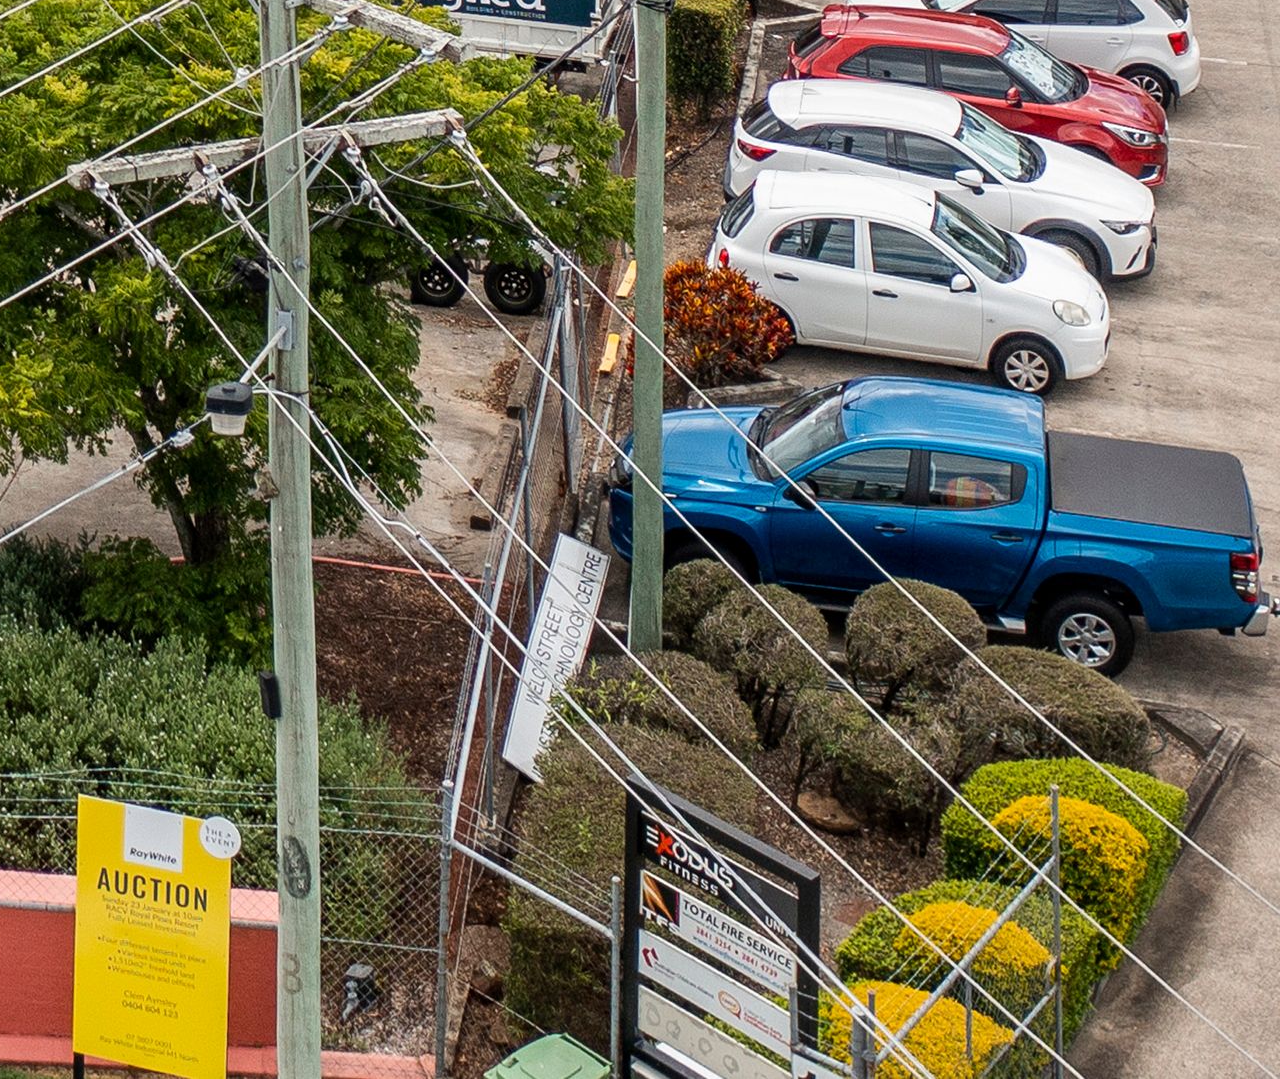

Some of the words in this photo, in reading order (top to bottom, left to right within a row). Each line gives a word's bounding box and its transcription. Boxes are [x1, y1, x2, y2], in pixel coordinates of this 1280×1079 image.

[465, 5, 494, 14] BUILDING
[500, 9, 546, 19] CONSTRUCTION
[576, 551, 602, 605] CENTRE
[536, 602, 565, 661] STREET
[205, 825, 223, 838] THE
[205, 836, 235, 849] EVENT
[646, 825, 734, 888] EXODUS
[97, 867, 207, 912] AUCTION
[102, 895, 128, 908] Sunday
[130, 899, 141, 908] 23
[142, 902, 171, 916] January
[105, 904, 127, 915] RACV
[130, 909, 151, 920] Royal
[152, 913, 173, 925] Pines
[174, 918, 199, 930] Resort
[108, 913, 125, 925] Fully
[128, 917, 153, 929] Leased
[155, 922, 196, 937] Investment
[765, 915, 789, 937] UNI
[683, 899, 719, 929] TOTAL
[721, 921, 745, 942] FIRE
[746, 936, 792, 970] SERVICE
[120, 939, 150, 953] different
[152, 946, 178, 958] tenants
[181, 951, 187, 959] in
[188, 954, 206, 965] place
[149, 961, 178, 976] freehold
[180, 968, 195, 979] land
[169, 959, 186, 968] units
[157, 973, 170, 983] and
[172, 977, 196, 990] offices
[124, 990, 145, 1002] Clem
[122, 1000, 143, 1012] 0404
[163, 1009, 179, 1019] 123
[114, 1038, 134, 1048] White
